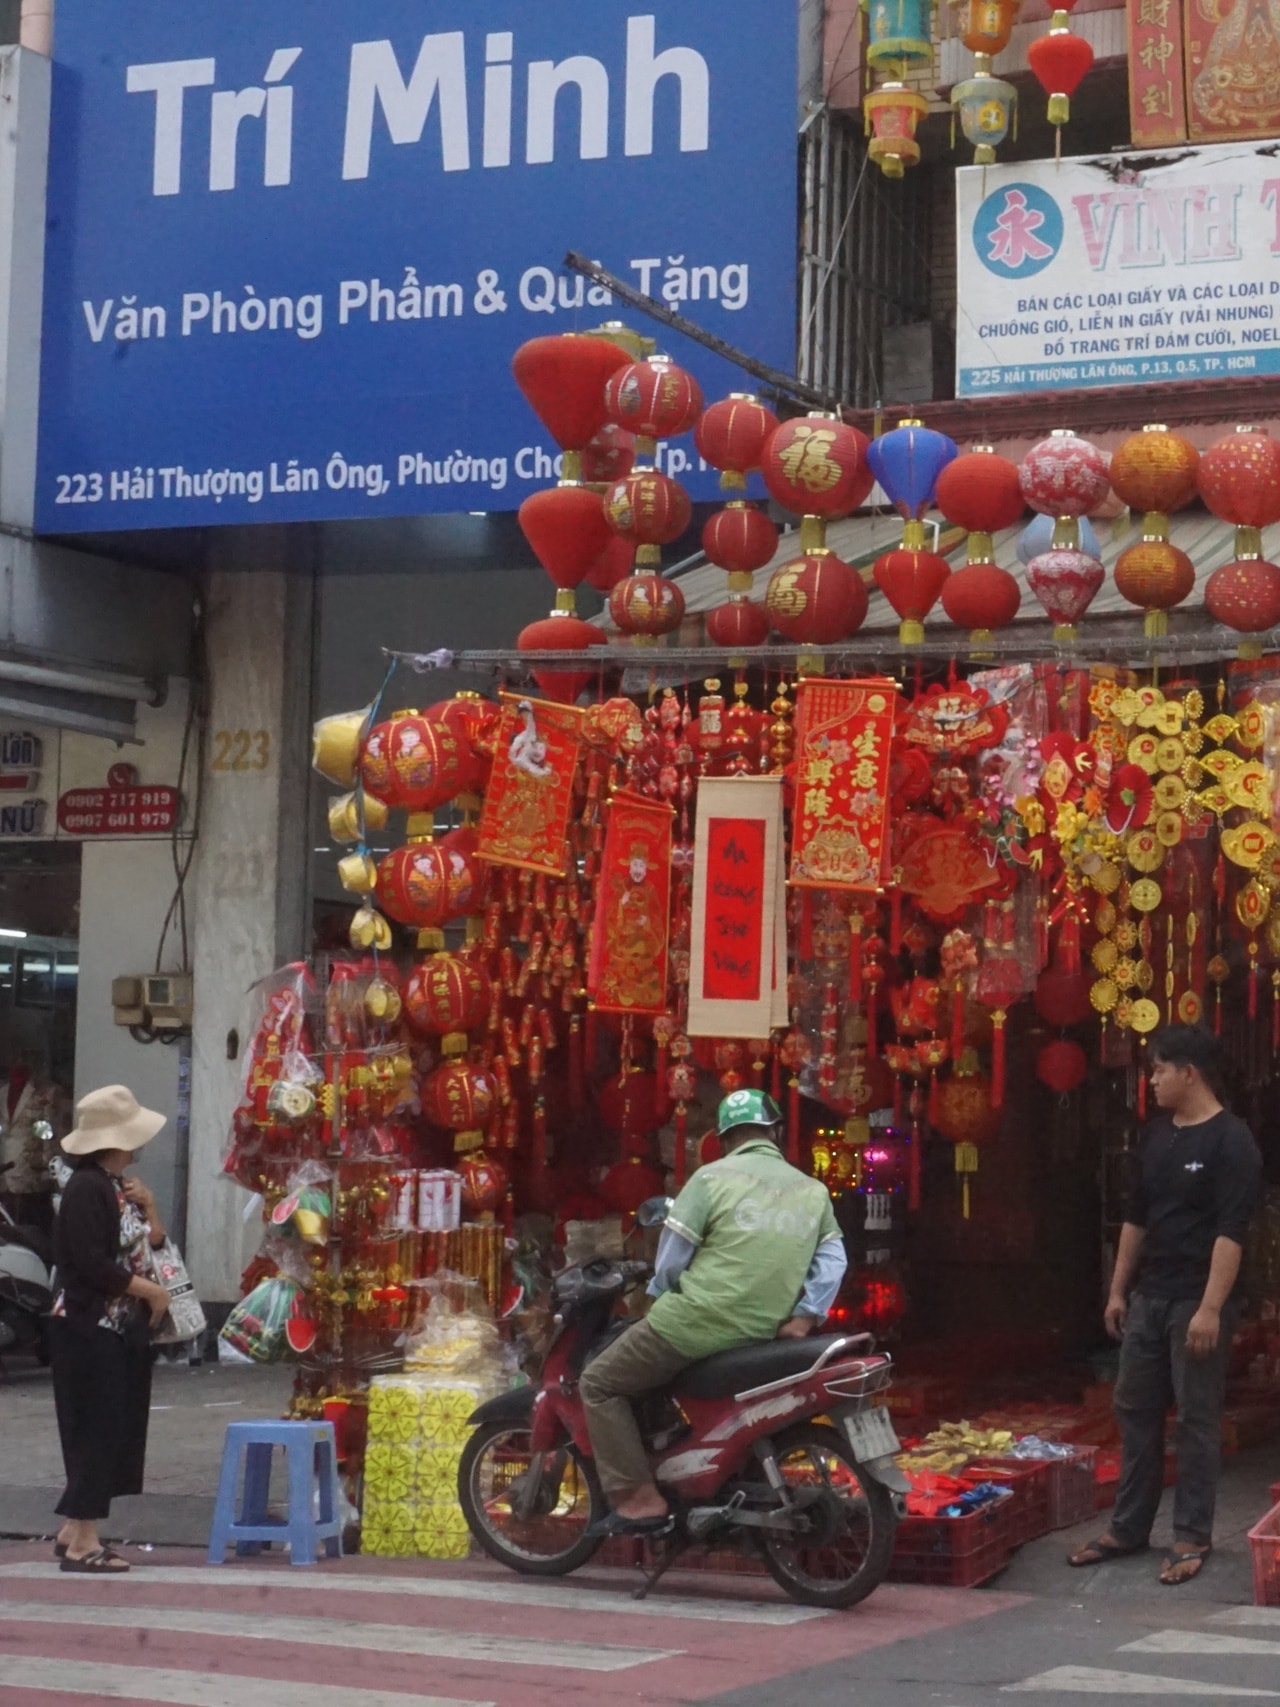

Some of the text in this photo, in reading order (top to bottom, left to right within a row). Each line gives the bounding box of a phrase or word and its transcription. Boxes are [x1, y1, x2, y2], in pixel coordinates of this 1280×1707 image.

[127, 14, 709, 195] Trí Minh
[988, 189, 1054, 268] 永
[83, 295, 166, 343] Văn
[182, 285, 322, 339] Phòng
[339, 267, 463, 324] Phẩm
[474, 269, 507, 314] &
[630, 255, 748, 311] Tặng
[1017, 297, 1048, 313] BÁN
[1053, 293, 1083, 311] CÁC
[1088, 291, 1122, 309] LOẠI
[1128, 284, 1161, 305] GIẤY
[1167, 284, 1187, 303] VÀ
[1193, 281, 1223, 301] CÁC
[1228, 278, 1264, 299] LOẠI
[978, 317, 1039, 339] CHUÔNG
[1044, 317, 1074, 335] GIÓ,
[1079, 310, 1114, 331] LIỄN
[1119, 313, 1134, 328] IN
[1139, 306, 1173, 327] GIẤY
[1180, 302, 1211, 326] (VẢI
[1216, 304, 1274, 322] NHUNG)
[1044, 336, 1066, 356] ĐỒ
[1070, 337, 1120, 355] TRANG
[1125, 333, 1149, 351] TRÍ
[1155, 330, 1190, 349] ĐÁM
[1195, 327, 1236, 348] CƯỚI,
[1242, 327, 1280, 343] NOEL
[970, 356, 1256, 386] 225 HẢI THƯỢNG LÃN ÔNG, P.13, Q.5, TP. HCM
[55, 474, 102, 503] 223
[110, 467, 153, 500] Hải
[159, 466, 263, 502] Thượng
[270, 460, 318, 493] Lãn
[325, 451, 390, 496] Ông,
[398, 450, 507, 490] Phường
[212, 729, 271, 772] 223
